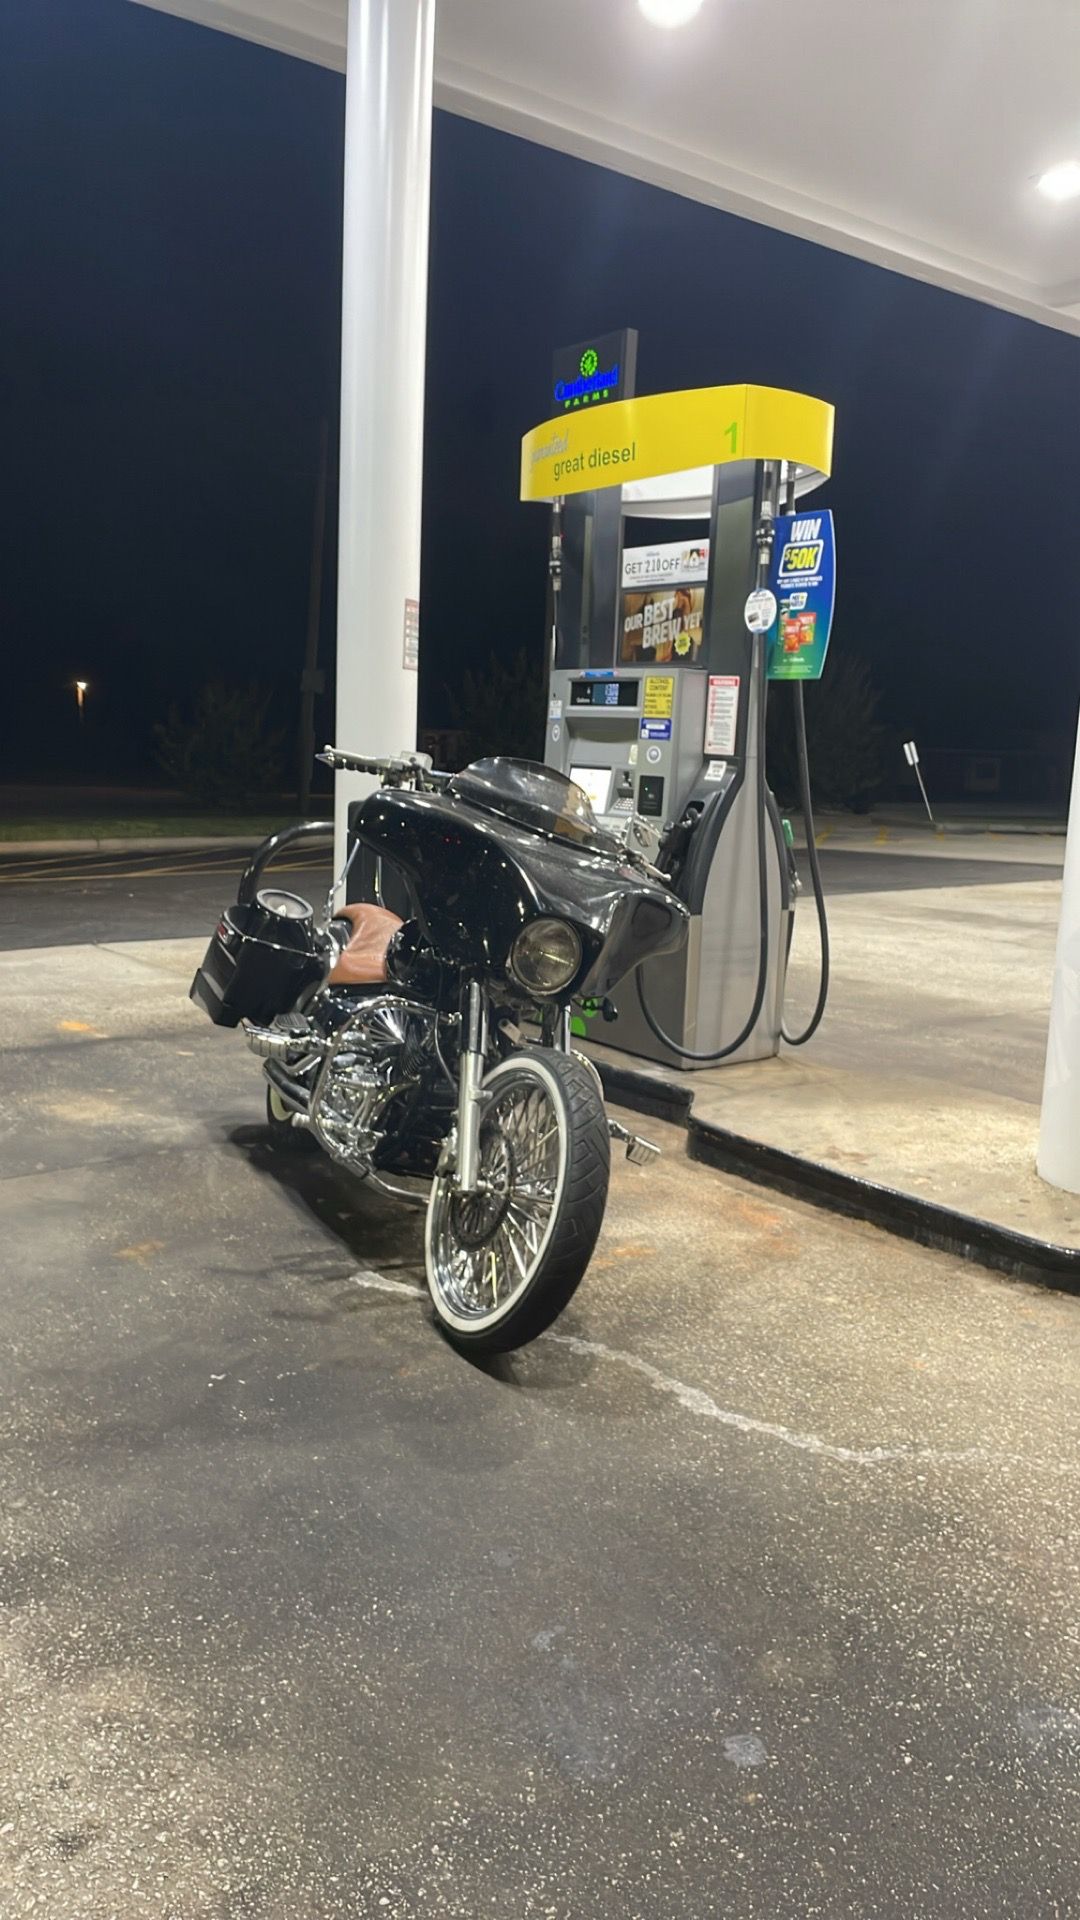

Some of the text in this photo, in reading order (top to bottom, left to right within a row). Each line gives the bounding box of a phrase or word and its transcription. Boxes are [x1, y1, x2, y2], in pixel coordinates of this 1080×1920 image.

[564, 389, 609, 409] FARMS
[723, 421, 738, 454] 1
[553, 453, 585, 481] great
[588, 442, 636, 469] diesel
[790, 517, 822, 542] WIN
[624, 562, 643, 575] GET
[662, 558, 681, 572] OFF
[784, 545, 818, 570] $50K
[624, 598, 675, 632] OUR BEST
[642, 611, 702, 649] BREW YET
